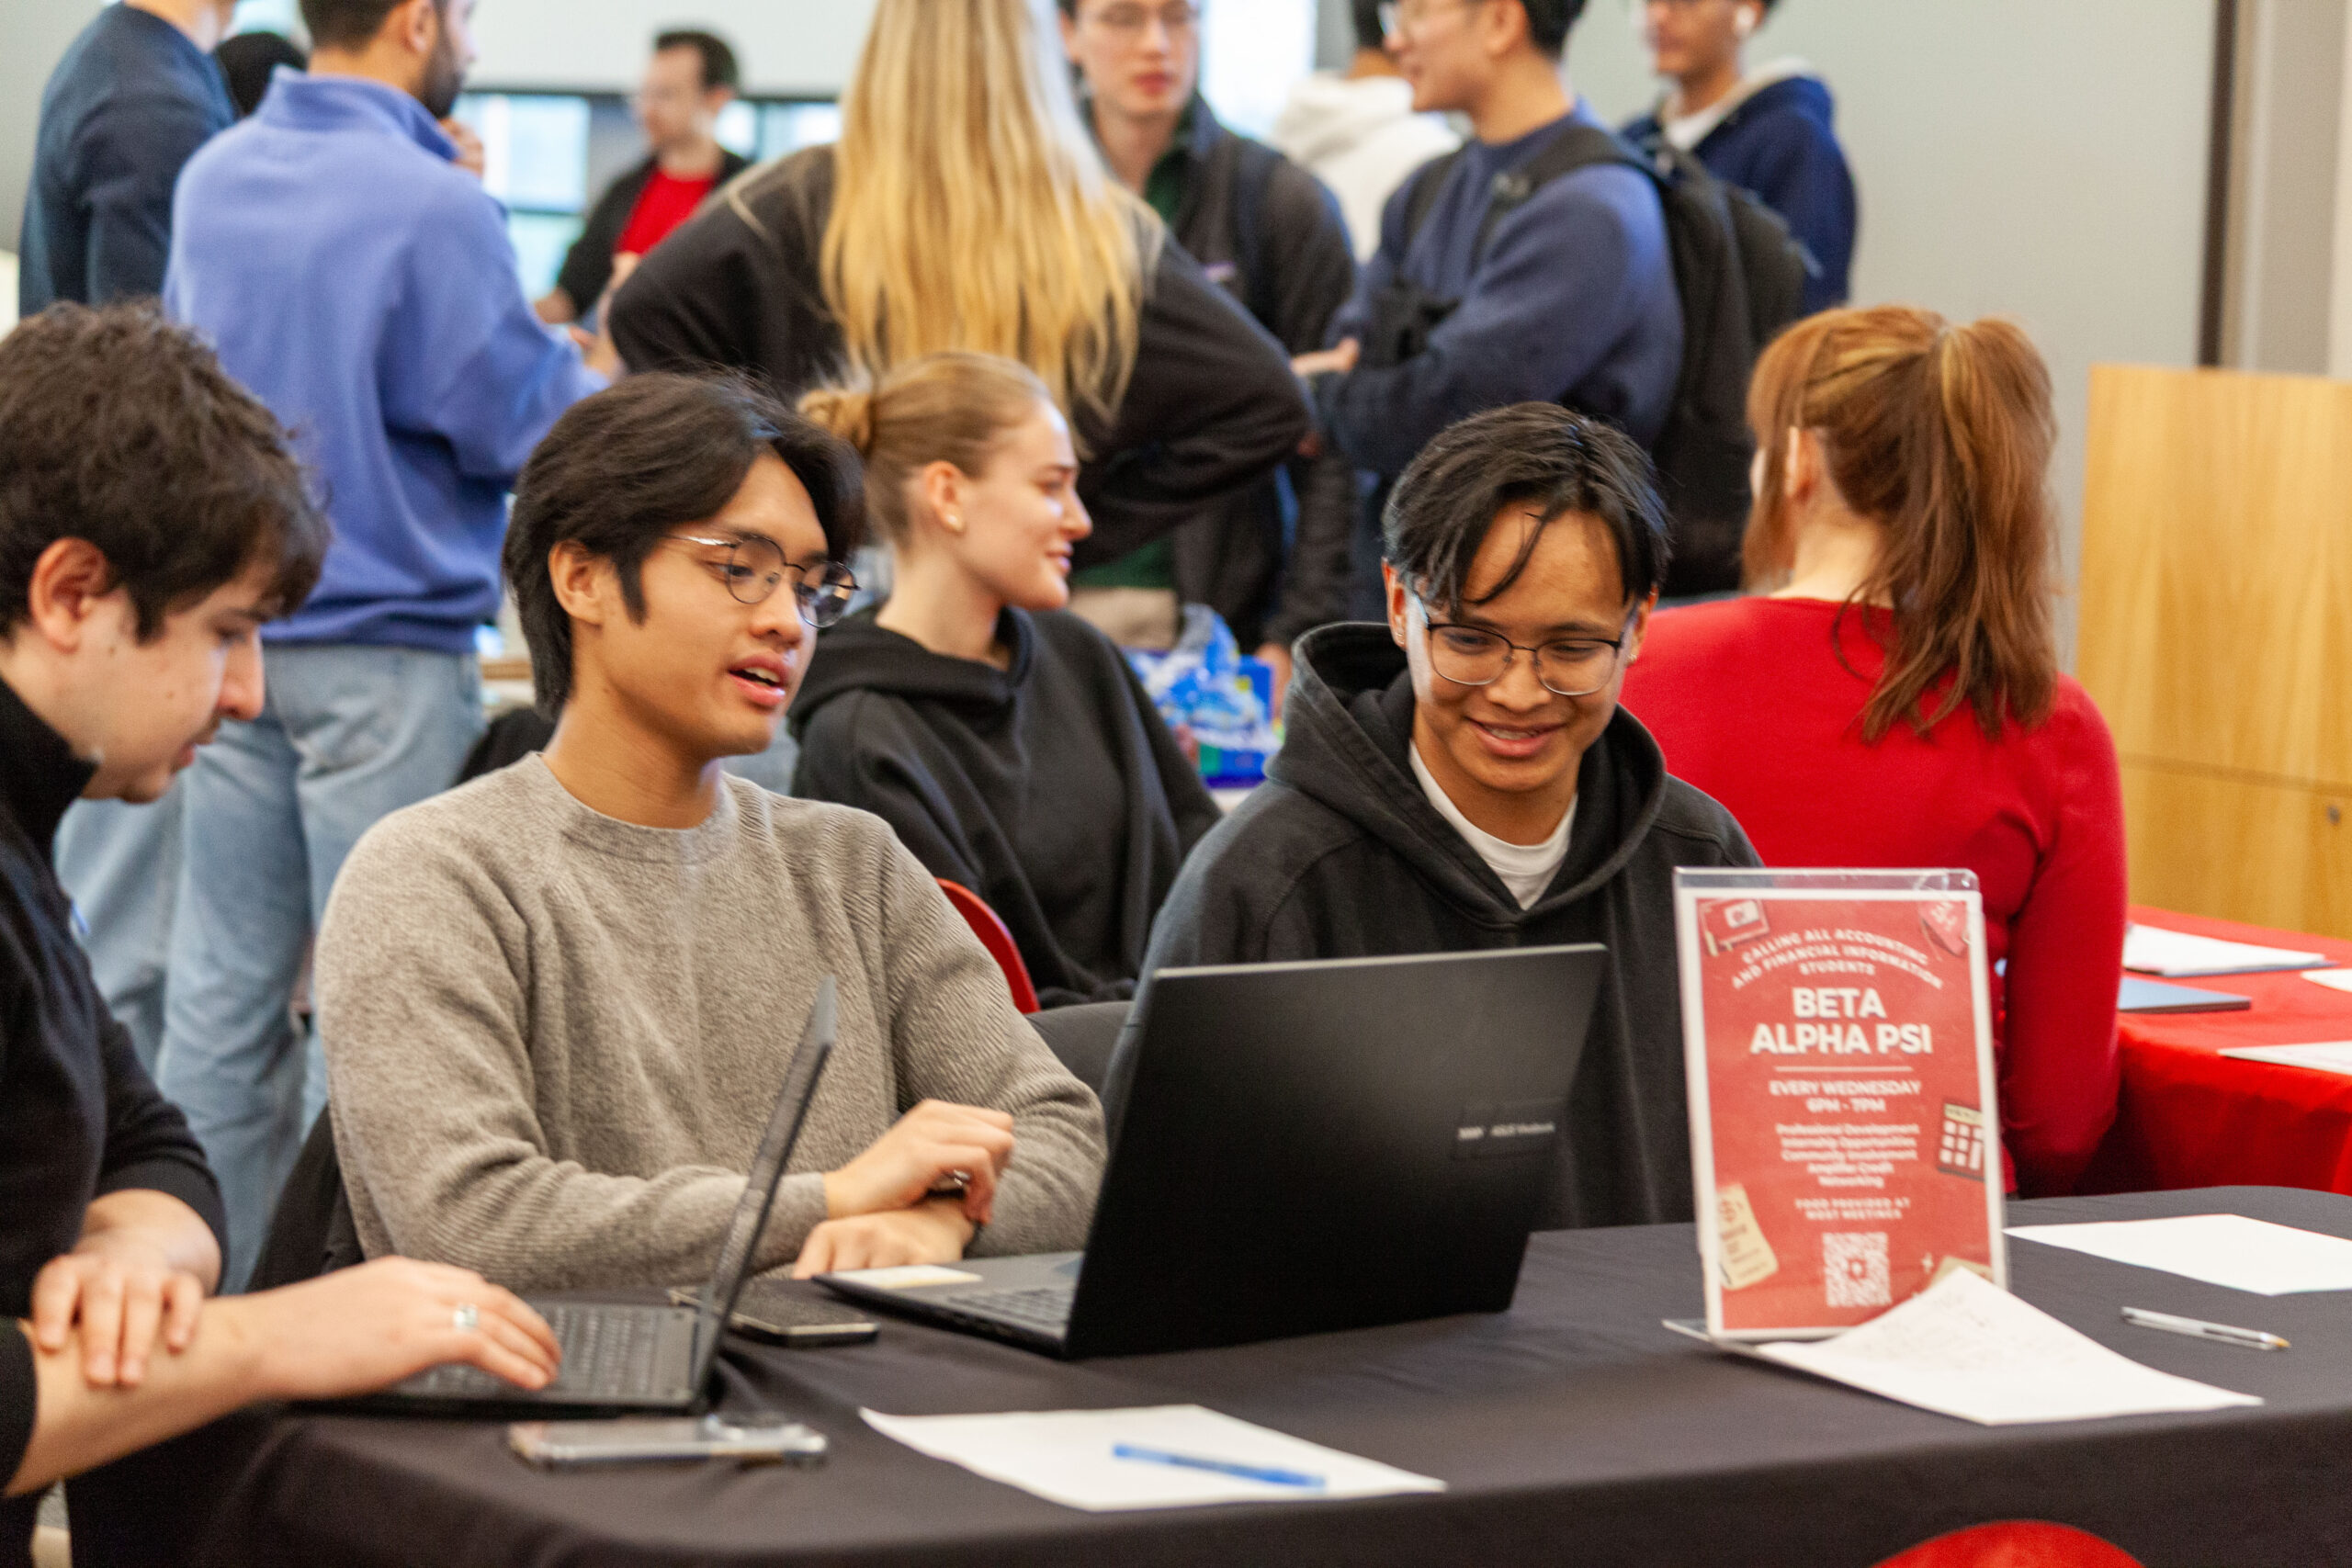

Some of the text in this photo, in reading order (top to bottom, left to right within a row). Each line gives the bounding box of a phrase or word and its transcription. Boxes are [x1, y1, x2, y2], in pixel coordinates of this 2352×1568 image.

[1742, 928, 1928, 965] CALLING ALL ACCOUNTING
[1732, 944, 1943, 990] AND FINANCIAL INFORMATION
[1799, 960, 1876, 976] STUDENTS
[1792, 987, 1887, 1019] BETA
[1749, 1022, 1933, 1055] ALPHA PSI
[1770, 1080, 1921, 1096] EVERY WEDNESDAY
[1806, 1098, 1840, 1112] 6PM
[1850, 1098, 1886, 1112] 7PM
[1817, 1175, 1885, 1189] Networking
[1795, 1197, 1911, 1209] FOOD PROVIDED AT
[1841, 1209, 1903, 1220] MEETINGS
